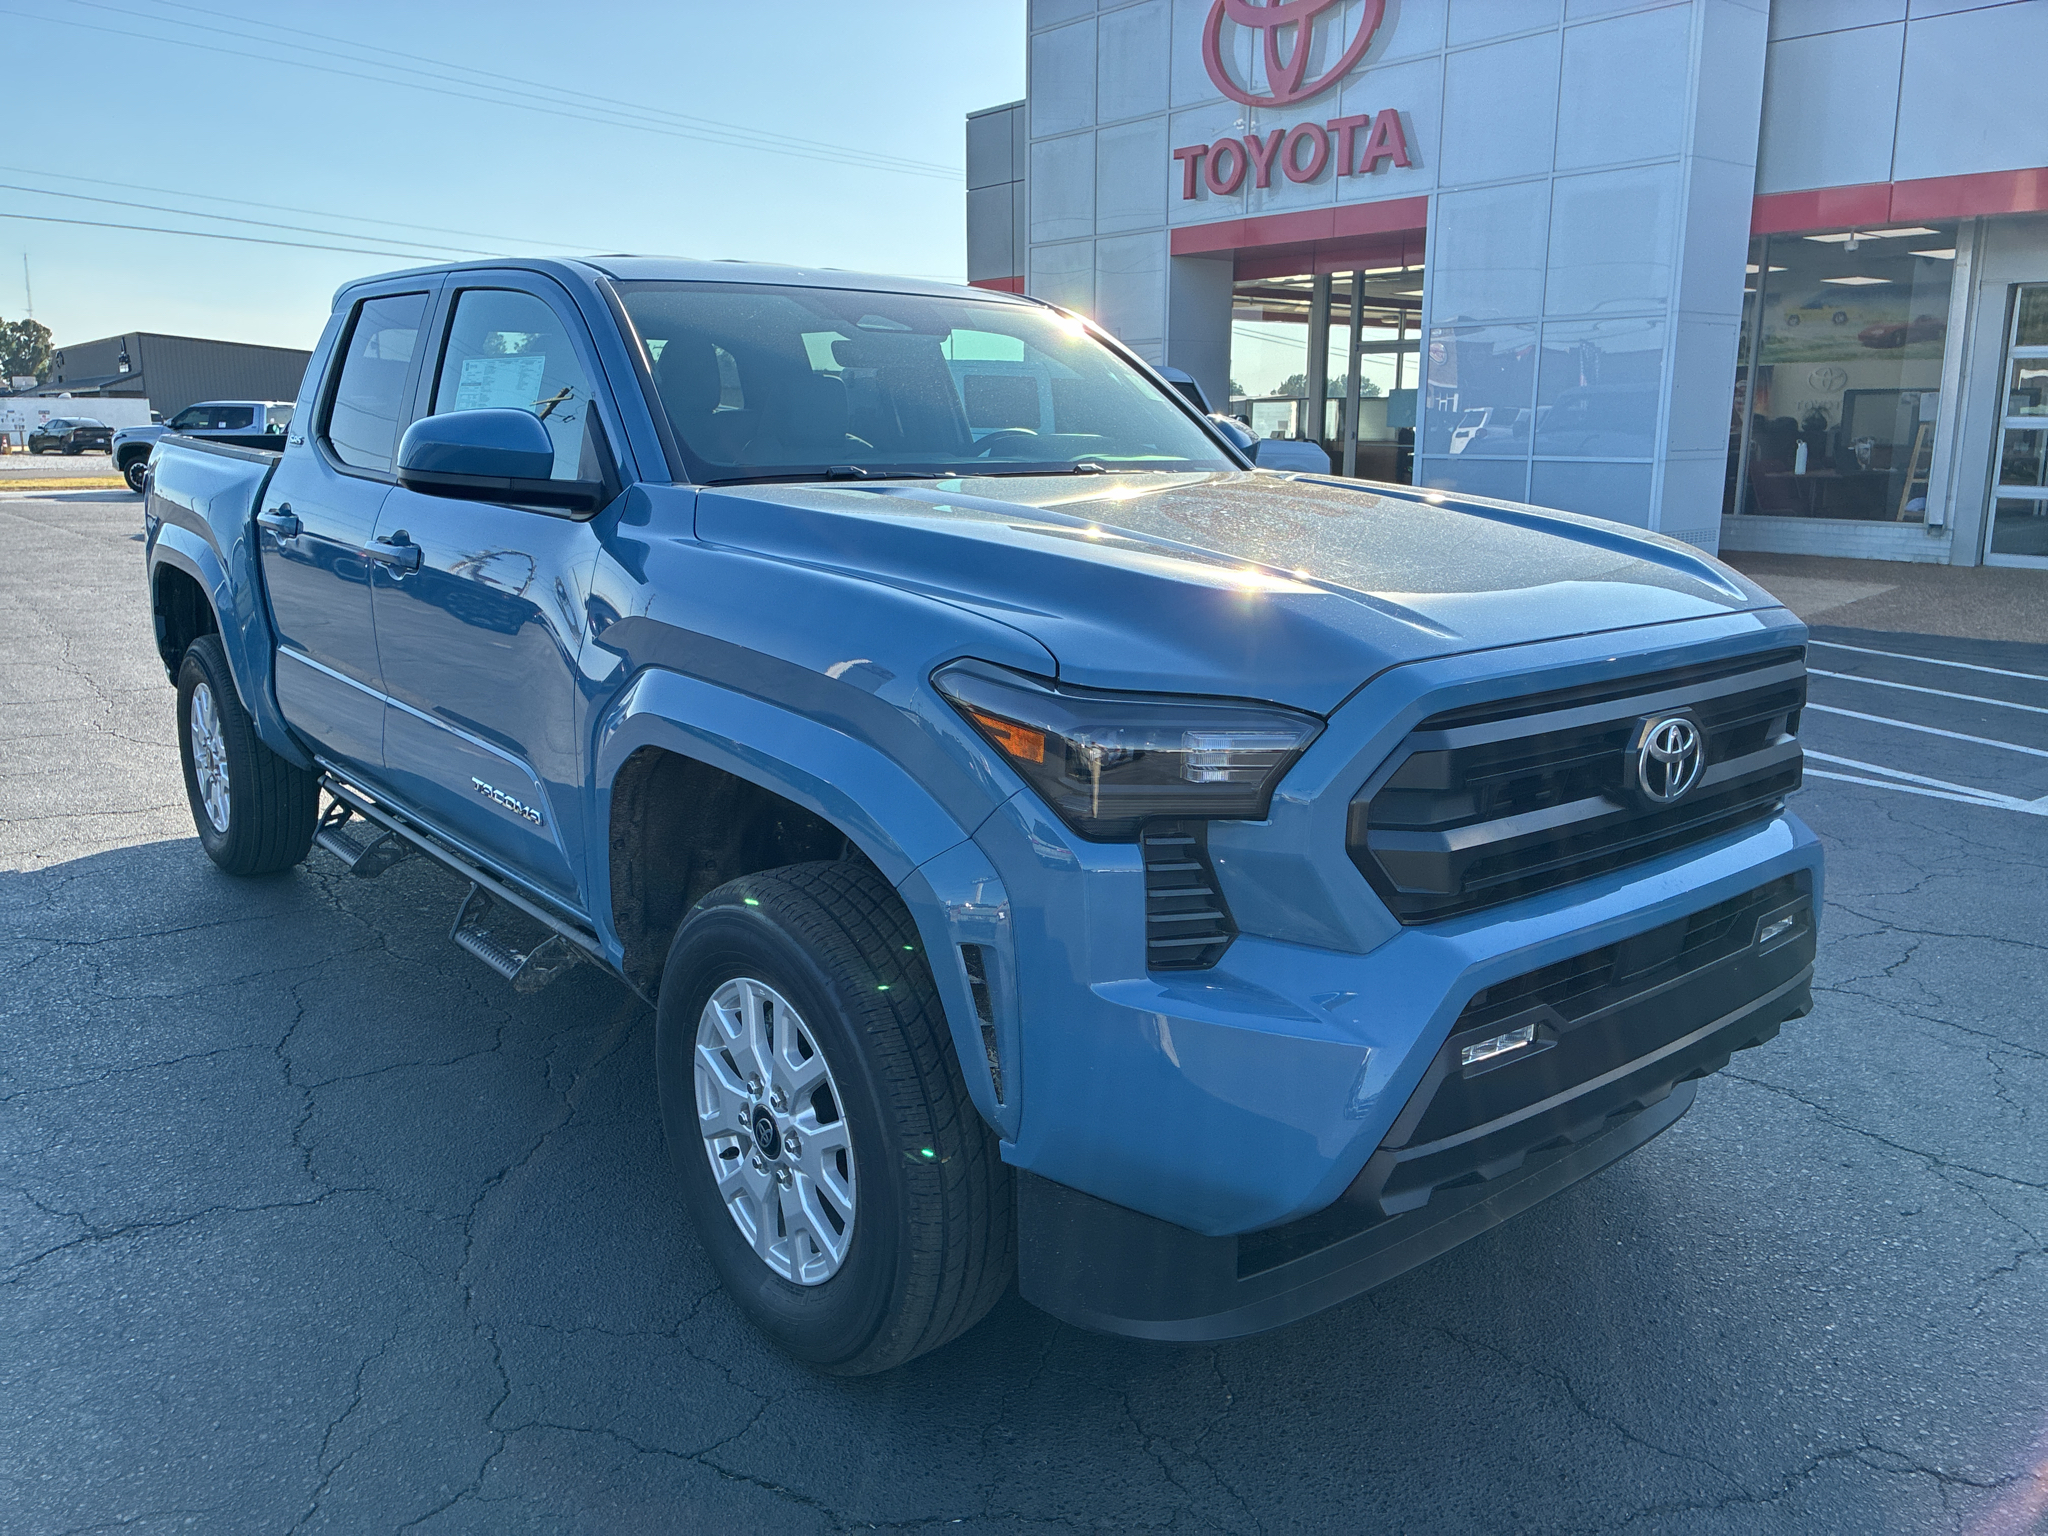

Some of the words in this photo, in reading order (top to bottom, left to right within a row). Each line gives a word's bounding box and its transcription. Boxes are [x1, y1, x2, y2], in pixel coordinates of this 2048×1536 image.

[1173, 108, 1412, 200] TOYOTA
[1796, 400, 1843, 412] TOYOT
[471, 776, 544, 827] TACOMA
